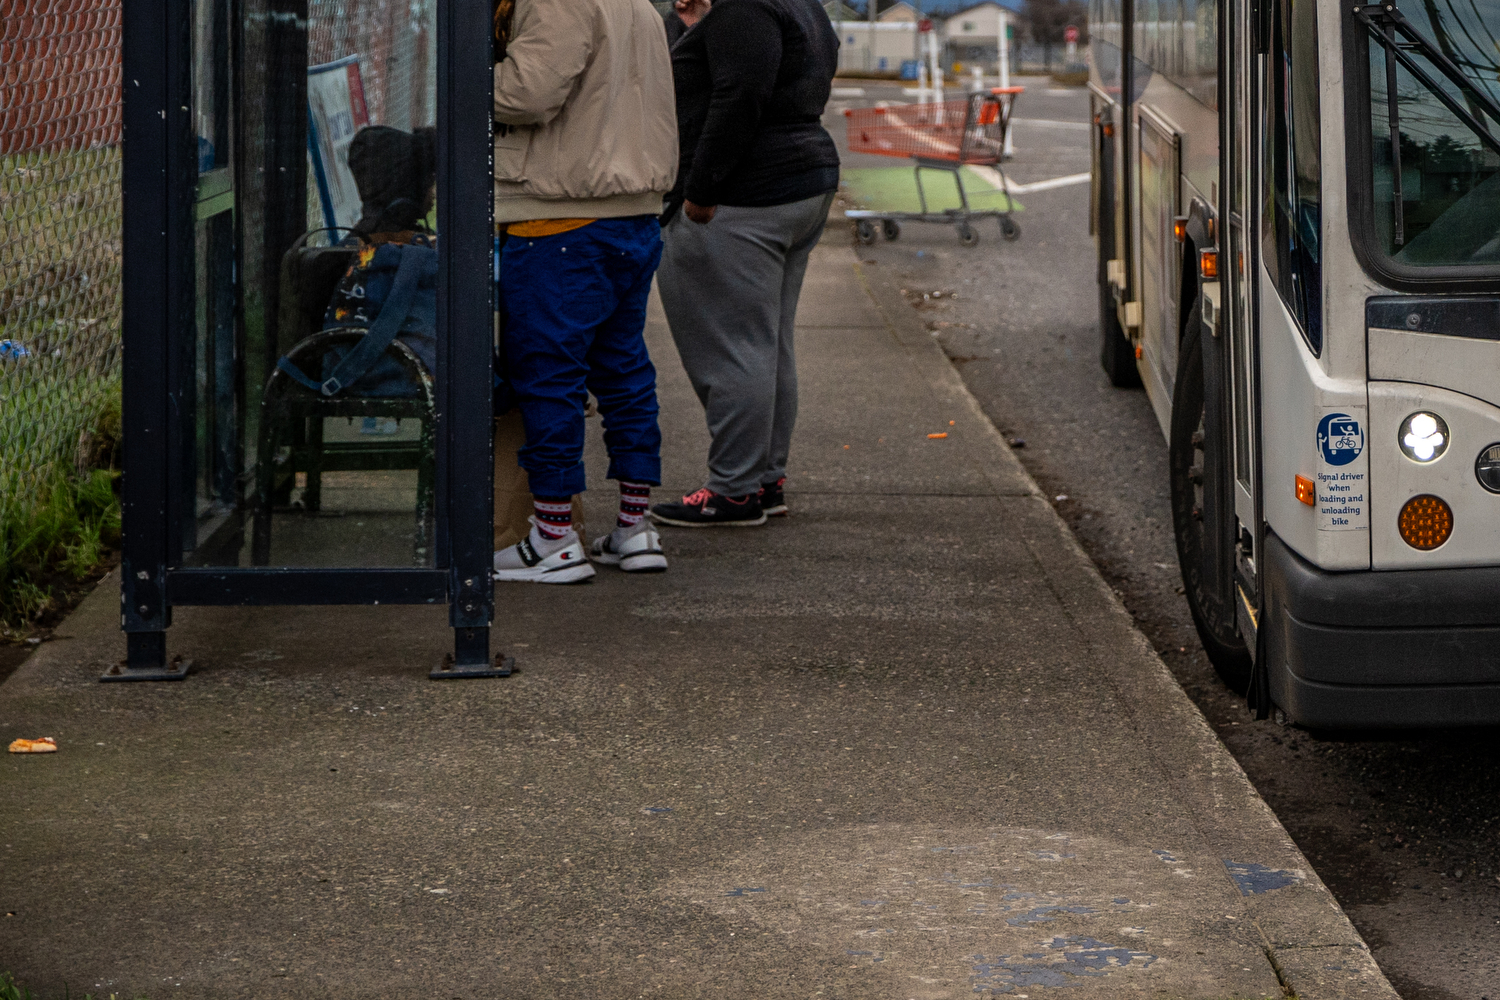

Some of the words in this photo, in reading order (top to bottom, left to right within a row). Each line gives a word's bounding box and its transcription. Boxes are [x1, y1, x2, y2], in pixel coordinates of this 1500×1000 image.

[1317, 473, 1339, 483] Signal
[1340, 473, 1364, 481] driver
[1319, 495, 1346, 504] loading
[1347, 494, 1364, 502] and
[1321, 507, 1361, 516] unloading
[1331, 517, 1349, 526] bike
